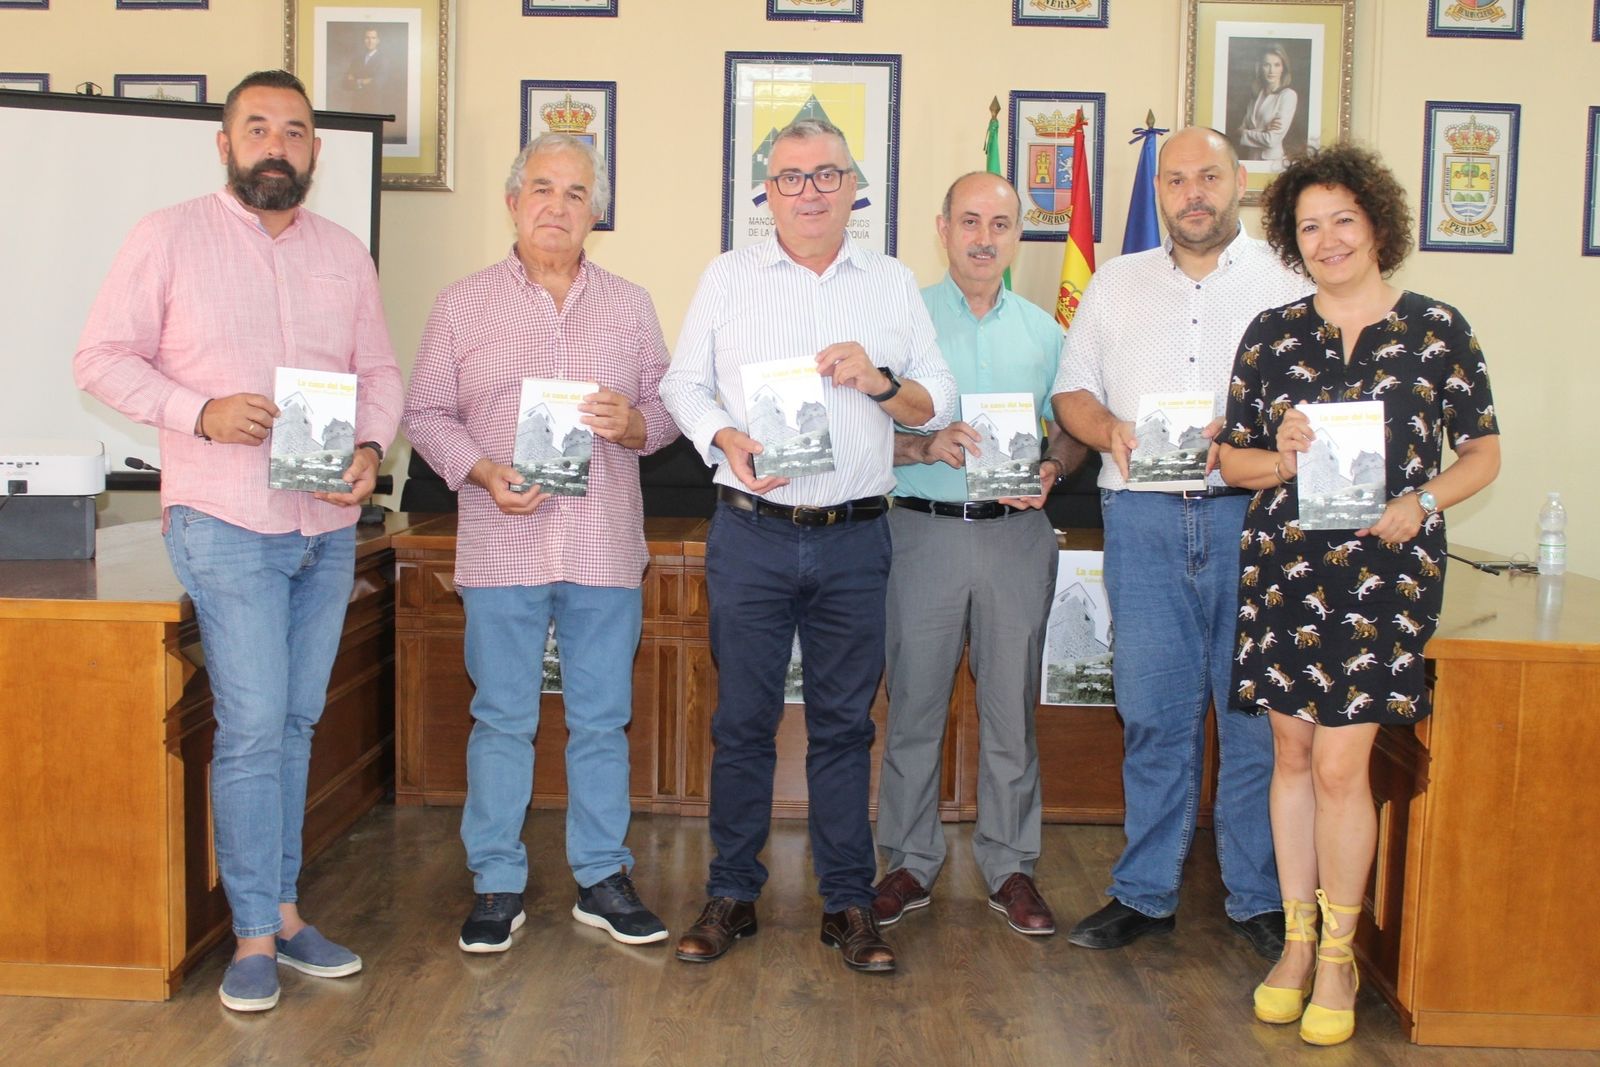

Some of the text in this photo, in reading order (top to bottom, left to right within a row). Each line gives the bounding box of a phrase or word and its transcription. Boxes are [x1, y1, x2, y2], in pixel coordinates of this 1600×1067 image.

[749, 217, 775, 225] MANCO
[749, 228, 759, 237] DE
[760, 228, 769, 237] LA
